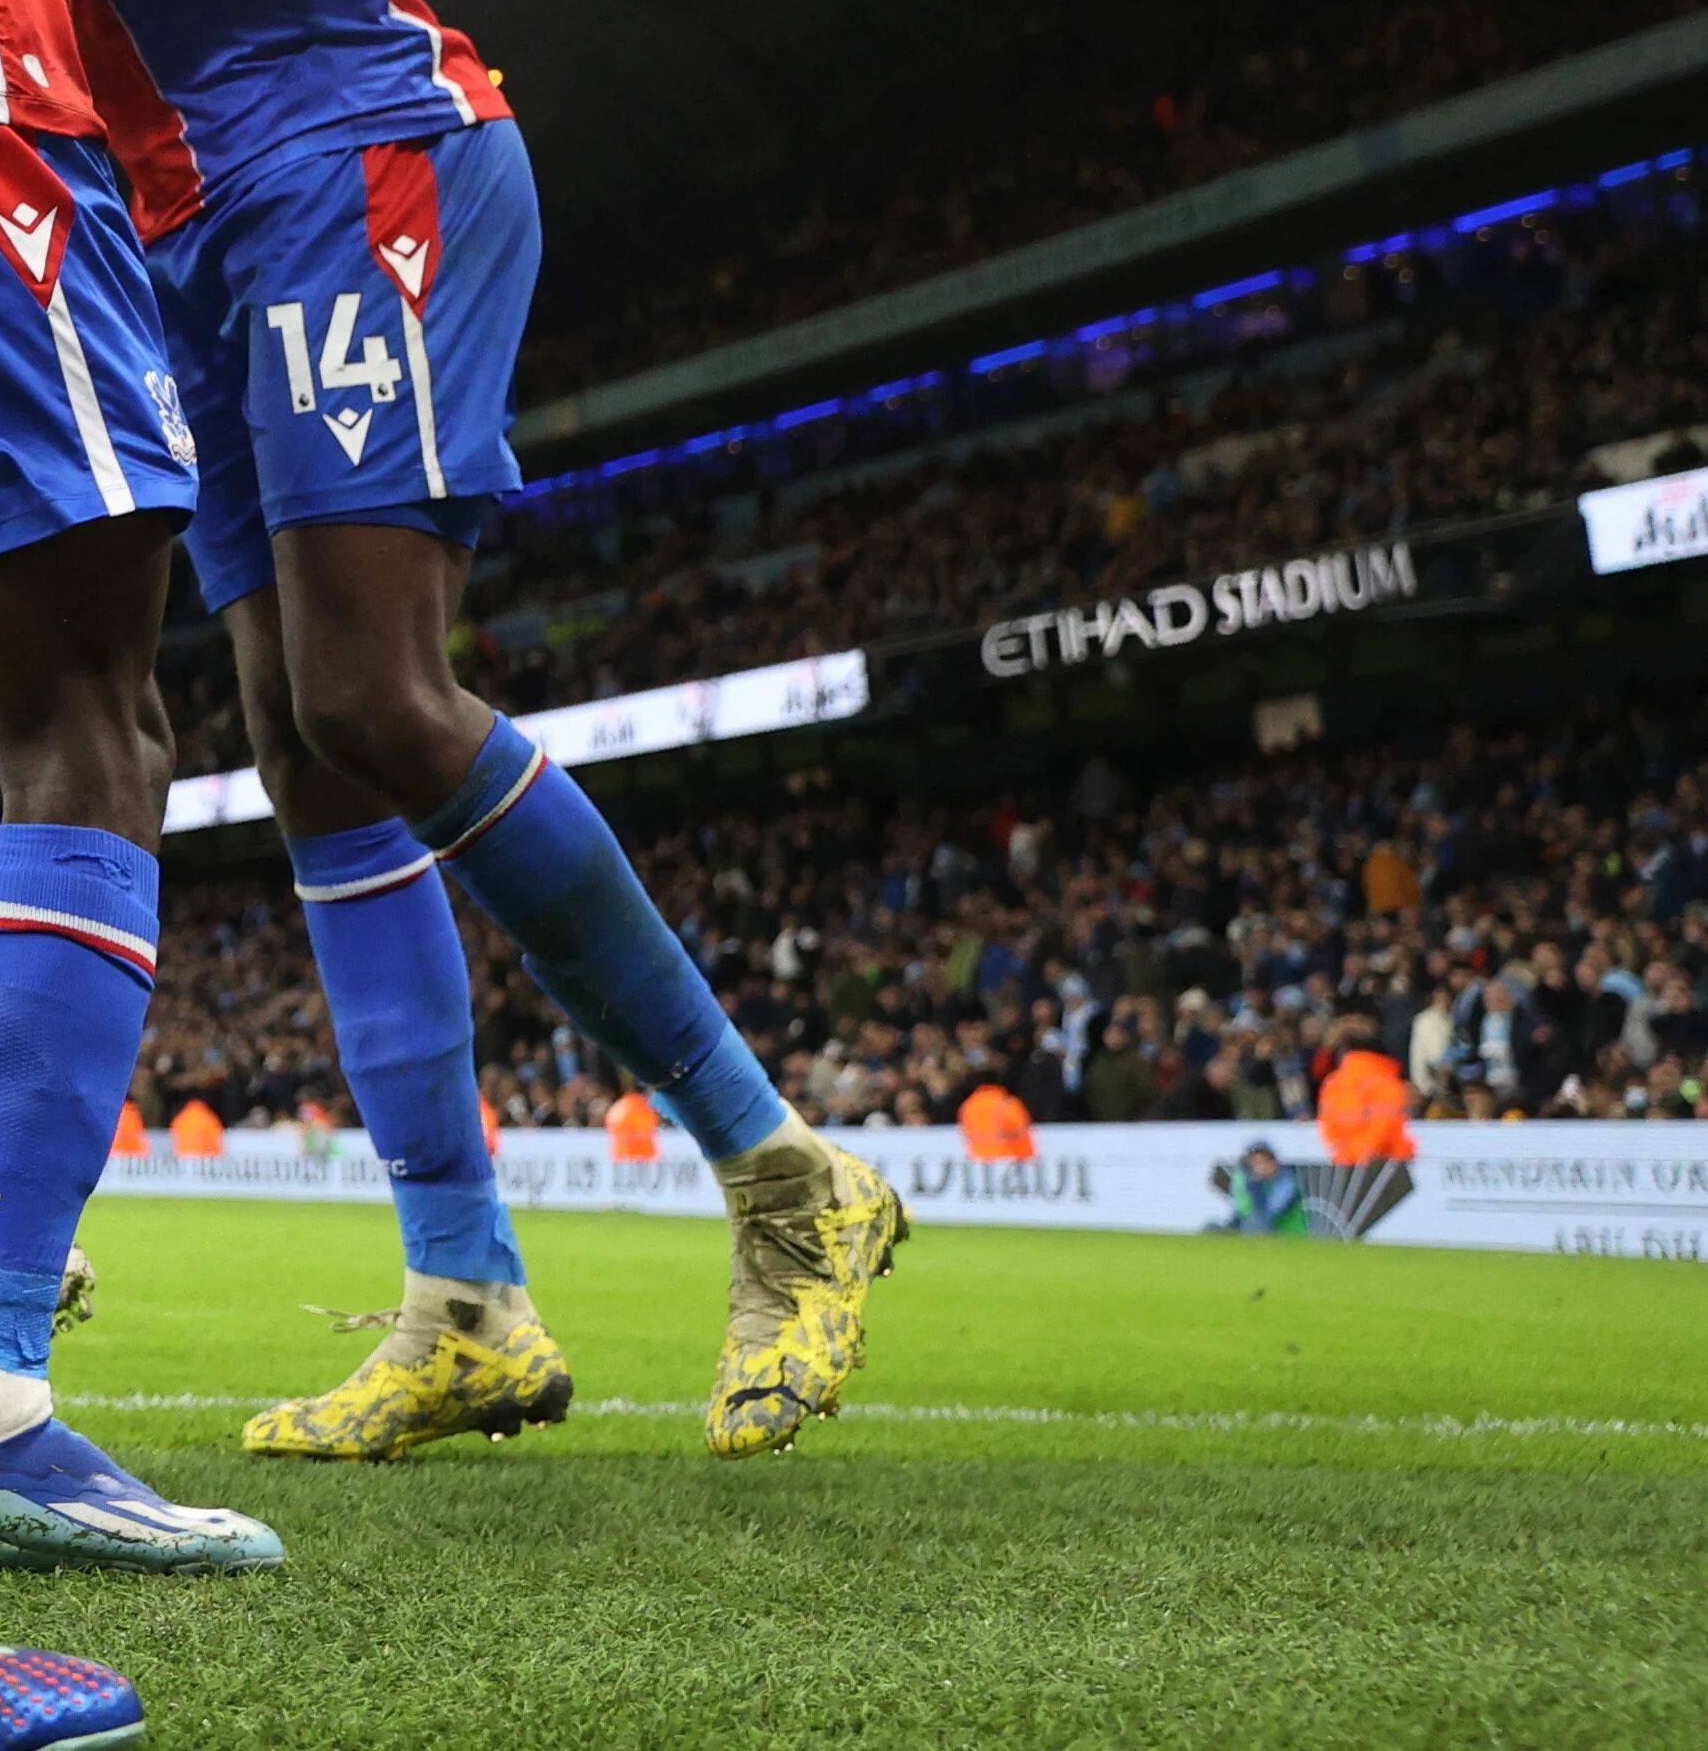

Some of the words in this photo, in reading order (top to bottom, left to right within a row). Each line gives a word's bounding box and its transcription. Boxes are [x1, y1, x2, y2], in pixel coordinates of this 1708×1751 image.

[266, 293, 403, 414] 14
[982, 584, 1209, 677] ETIHAD
[1211, 541, 1417, 635] STADIUM
